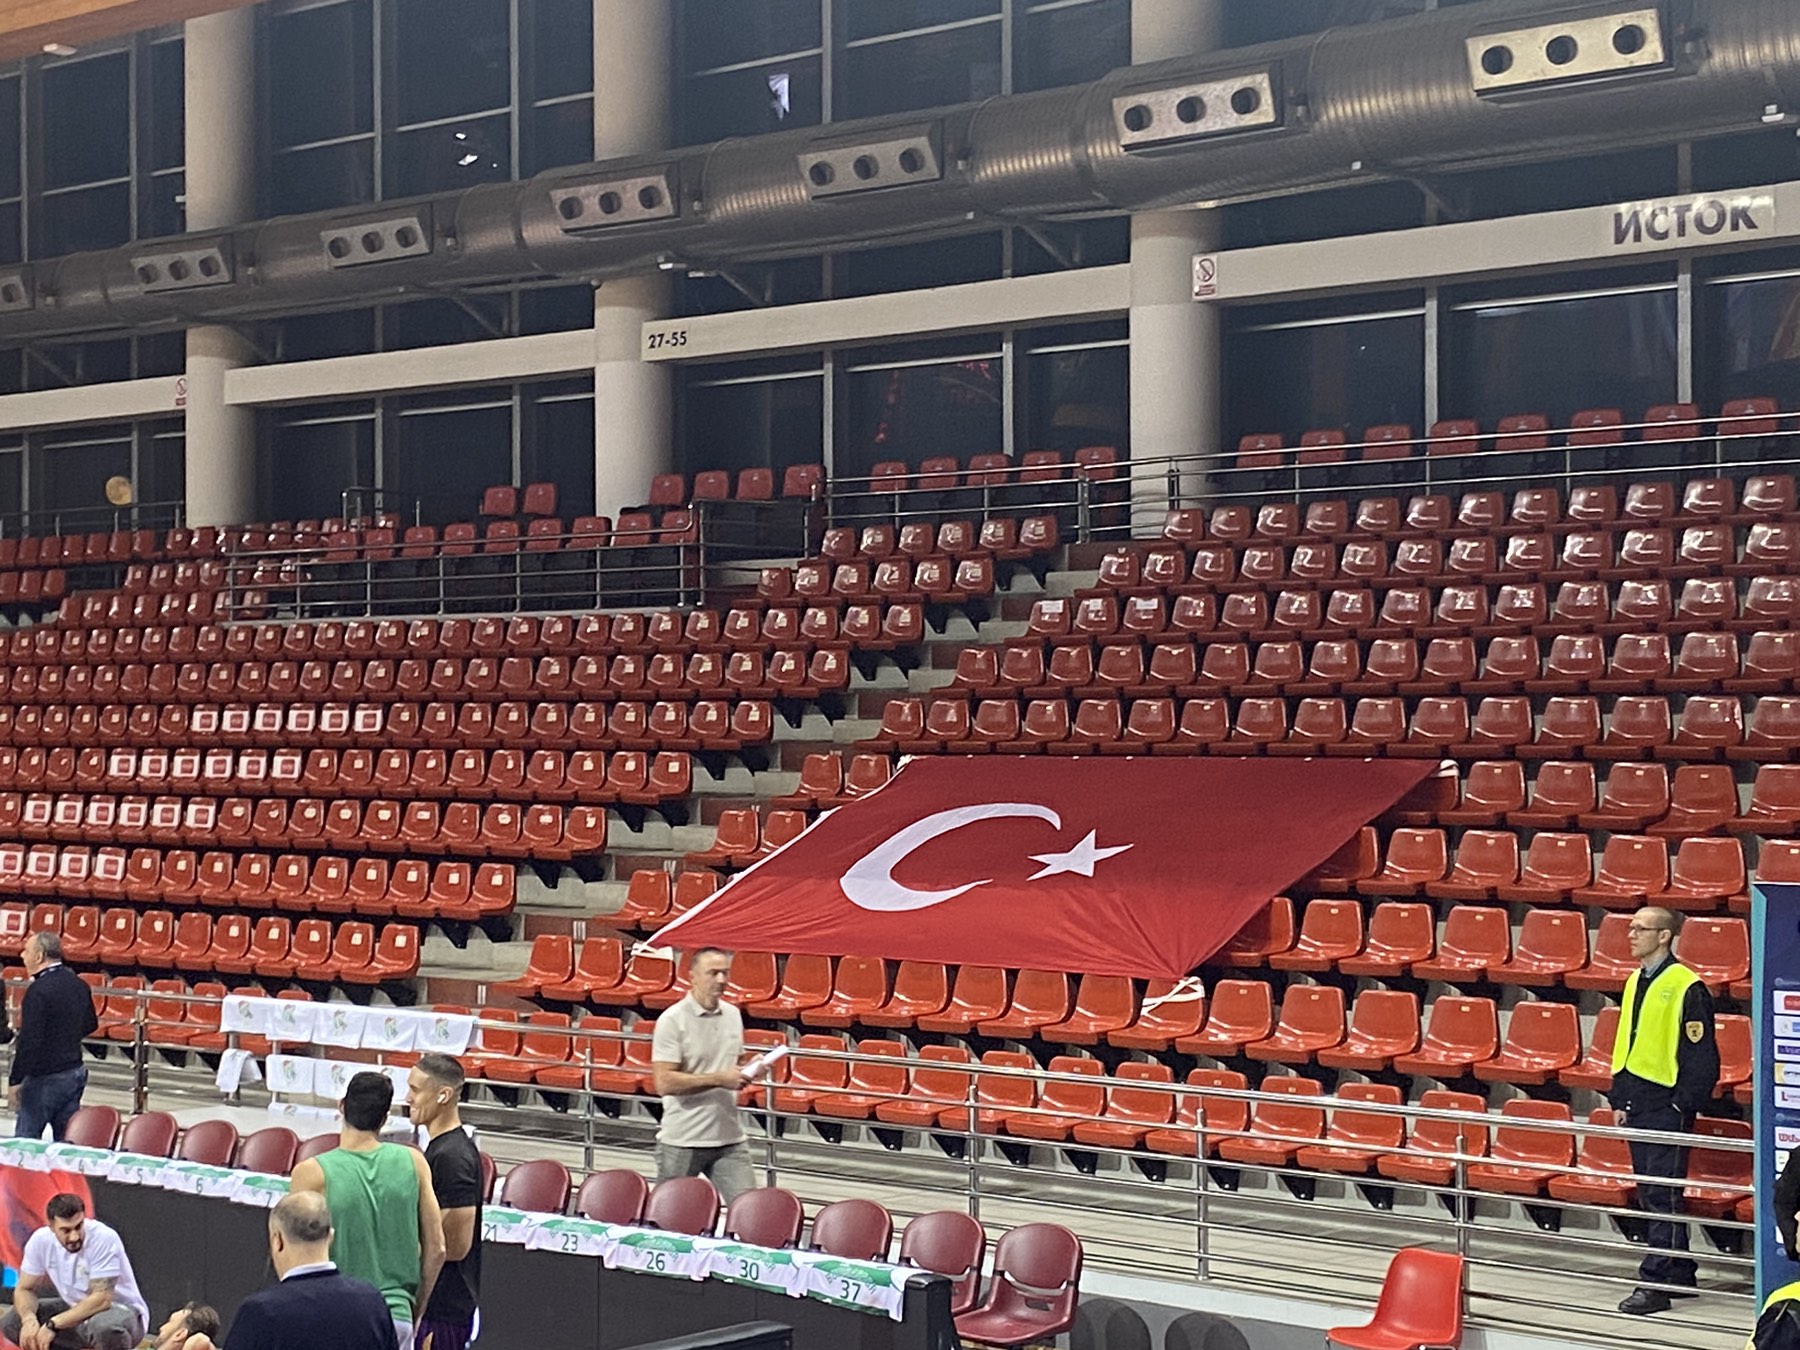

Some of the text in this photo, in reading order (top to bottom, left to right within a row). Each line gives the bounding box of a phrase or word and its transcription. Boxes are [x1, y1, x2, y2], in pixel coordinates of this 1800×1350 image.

[1614, 200, 1758, 245] ИСТОК
[648, 331, 687, 349] 27-55
[196, 1177, 204, 1194] 6
[266, 1191, 273, 1208] 7
[484, 1223, 497, 1242] 21
[562, 1233, 579, 1252] 23
[646, 1251, 666, 1271] 26
[740, 1260, 760, 1281] 30
[841, 1280, 861, 1302] 37
